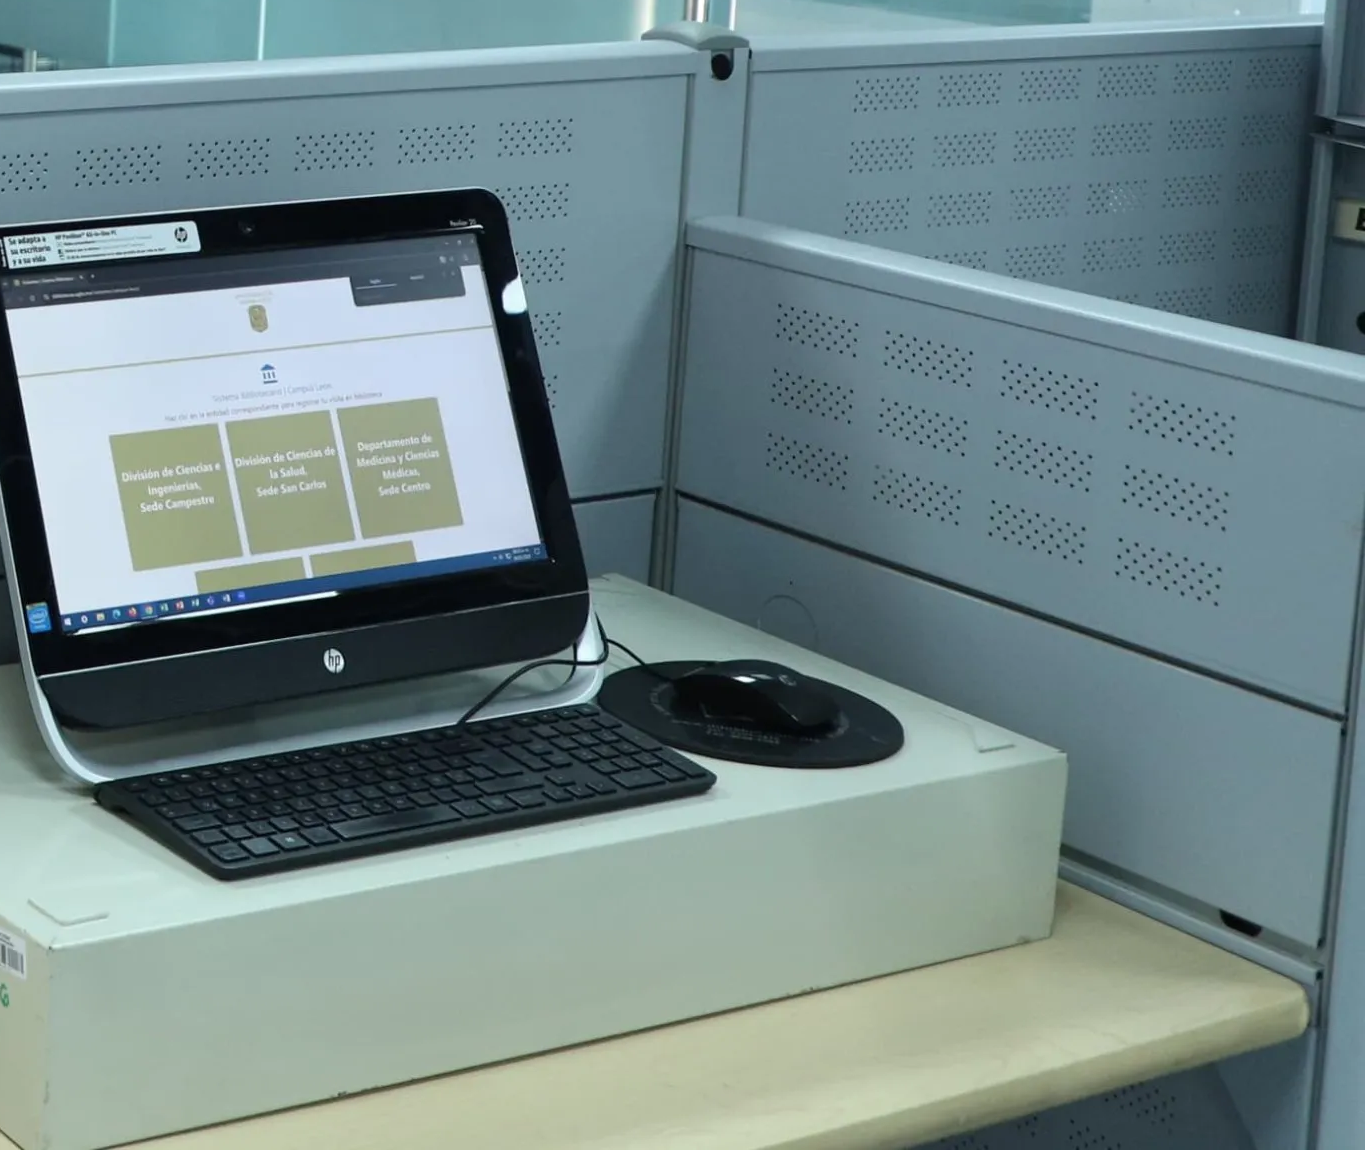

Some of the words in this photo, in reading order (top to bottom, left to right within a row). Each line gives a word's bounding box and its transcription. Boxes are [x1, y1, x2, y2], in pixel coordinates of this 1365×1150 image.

[9, 237, 16, 245] Se
[18, 235, 41, 245] adapta
[19, 245, 51, 254] escritorio
[32, 254, 47, 263] vida
[357, 435, 420, 452] Departamento
[421, 431, 432, 443] de
[234, 455, 271, 468] División
[272, 452, 284, 463] de
[286, 447, 323, 461] Ciencias
[324, 445, 336, 456] de
[356, 455, 396, 467] Medicina
[397, 454, 404, 465] y
[405, 448, 440, 461] Ciencias
[121, 467, 160, 482] División
[162, 466, 174, 477] de
[175, 461, 213, 475] Ciencias
[214, 462, 221, 471] e
[269, 469, 279, 479] la
[256, 485, 278, 497] Sede
[280, 483, 298, 494] San
[299, 480, 327, 492] Carlos
[378, 484, 400, 496] Sede
[401, 481, 431, 494] Centro
[140, 501, 164, 513] Sede
[165, 495, 215, 510] Campestre
